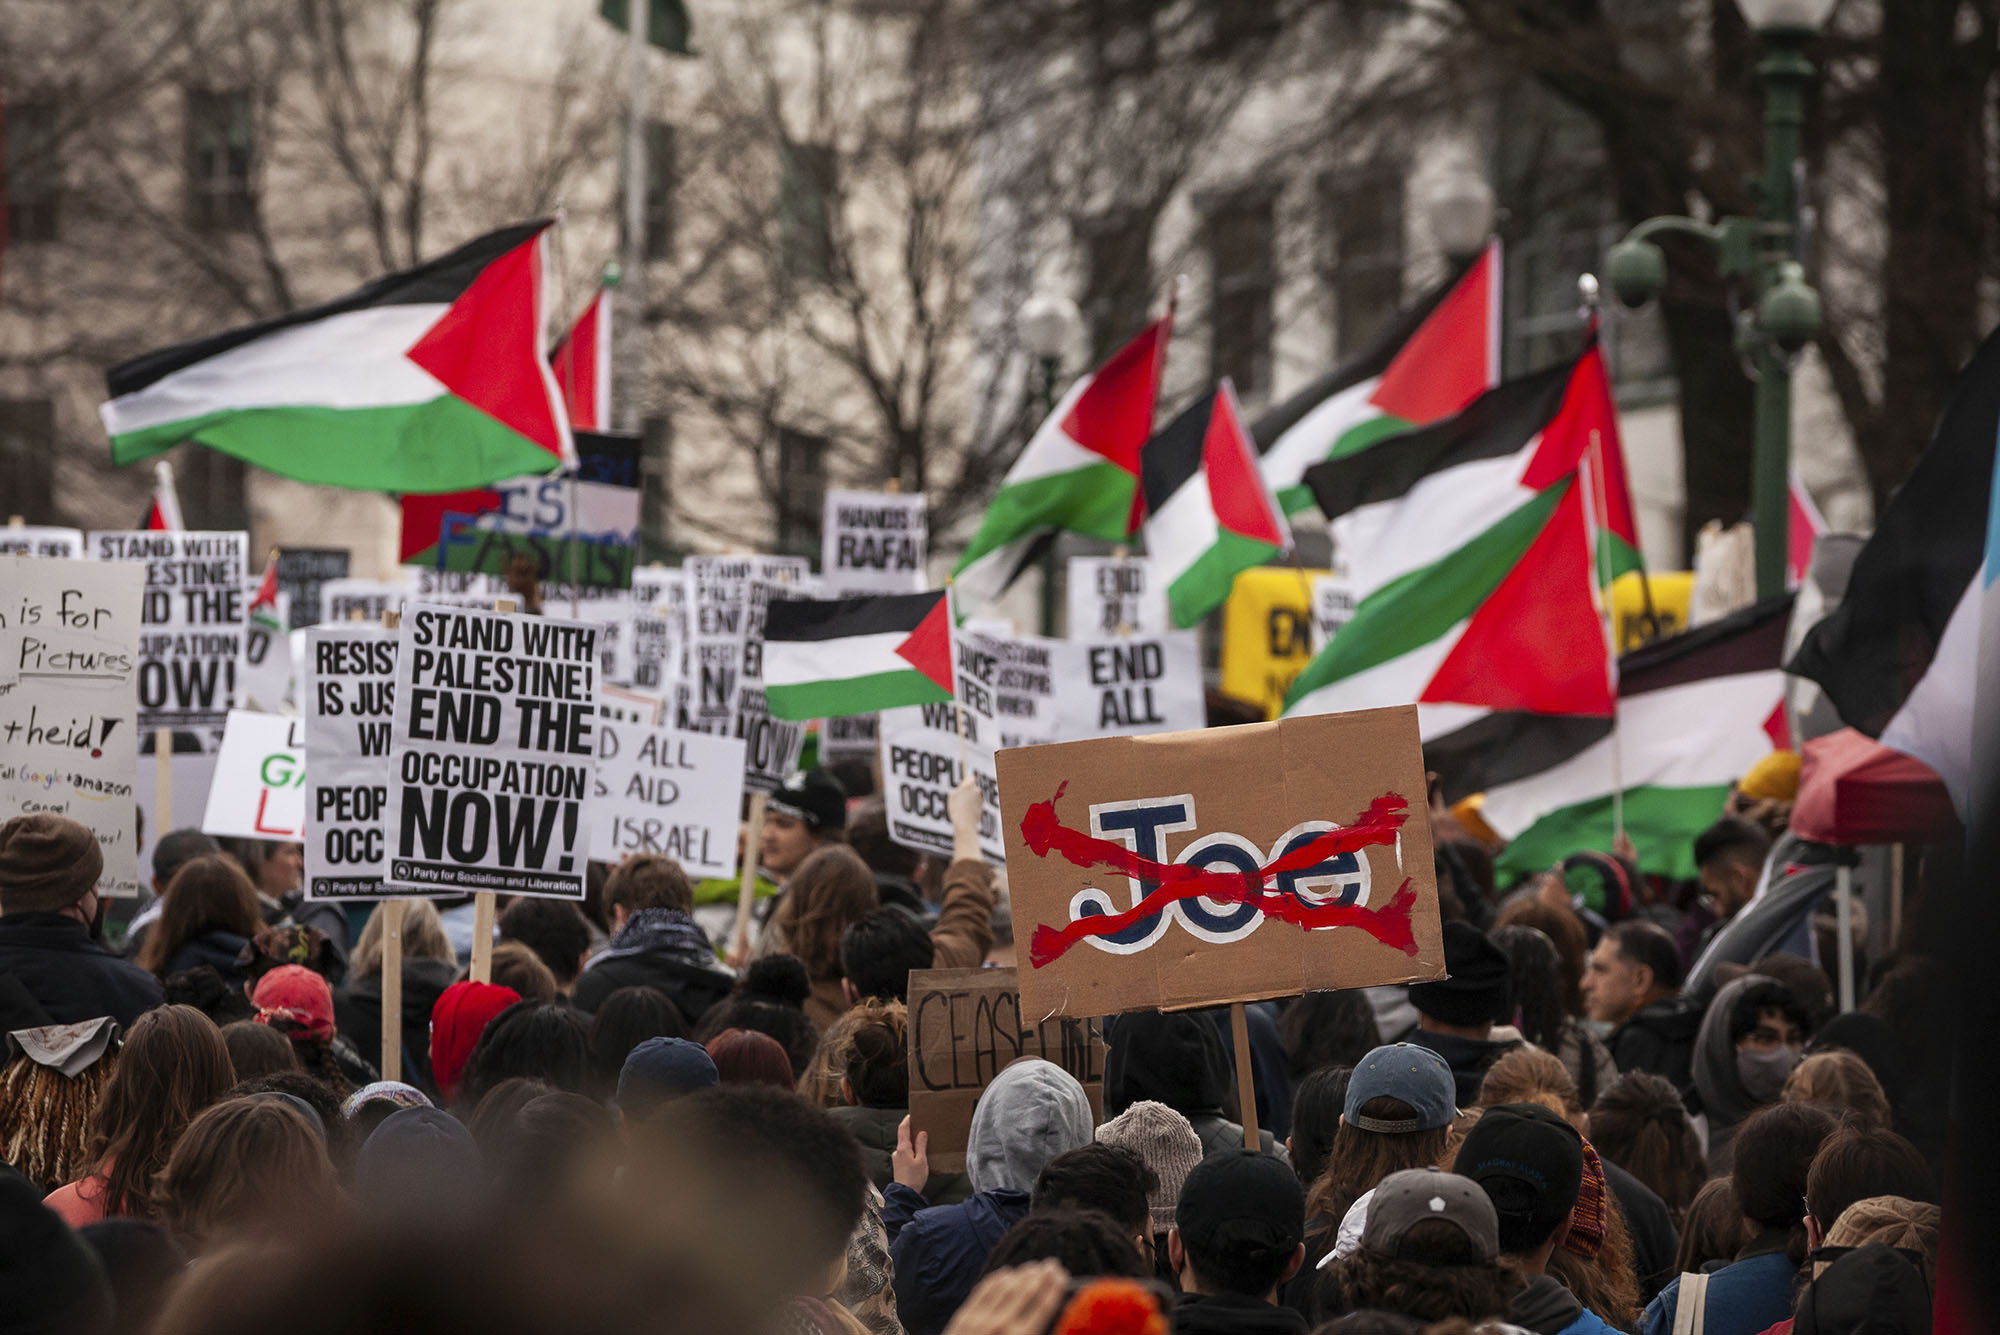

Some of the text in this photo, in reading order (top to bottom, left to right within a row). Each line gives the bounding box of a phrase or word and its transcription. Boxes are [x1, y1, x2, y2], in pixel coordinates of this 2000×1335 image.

[101, 536, 239, 560] STAND WITH
[20, 597, 42, 625] is
[56, 588, 112, 630] for
[184, 590, 242, 624] THE
[20, 636, 132, 673] Pictures
[414, 610, 513, 653] STAND
[522, 621, 597, 662] WITH
[412, 648, 593, 702] PALESTINE!
[1088, 642, 1165, 685] END
[318, 682, 343, 716] IS
[1099, 686, 1166, 729] ALL
[408, 687, 595, 756] END THE
[637, 733, 697, 770] ALL
[401, 750, 587, 801] OCCUPATION
[625, 771, 680, 806] AID
[398, 785, 580, 873] NOW!
[612, 815, 724, 867] ISRAEL
[413, 866, 579, 892] Party for Socialism and Liberation
[1069, 793, 1371, 956] Joe
